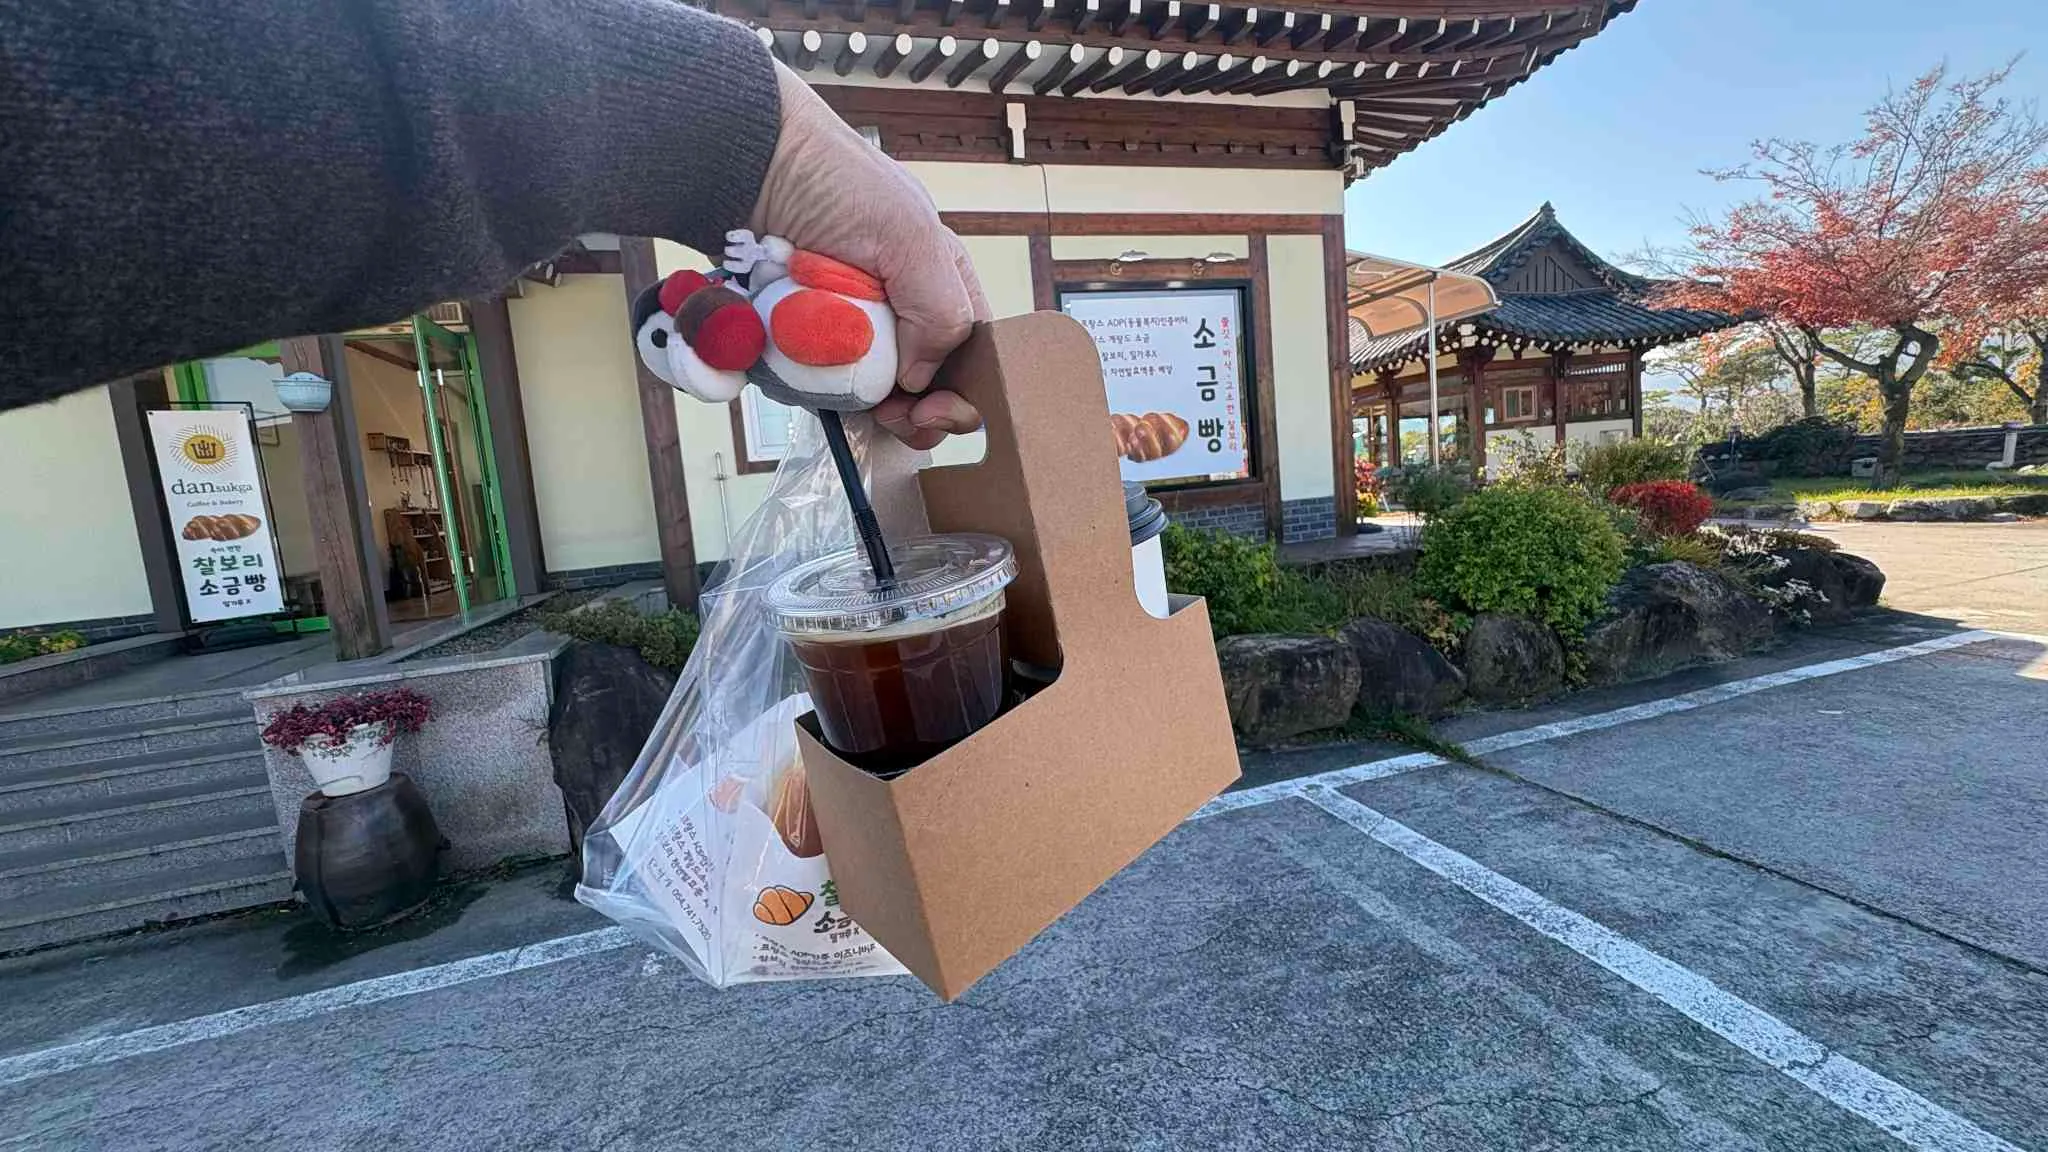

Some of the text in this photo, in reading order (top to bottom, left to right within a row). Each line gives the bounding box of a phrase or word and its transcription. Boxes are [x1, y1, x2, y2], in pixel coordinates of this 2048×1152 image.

[1193, 317, 1225, 453] 소금빵
[171, 479, 253, 495] dansukga
[192, 553, 264, 576] 찰보리
[199, 573, 267, 596] 소금빵
